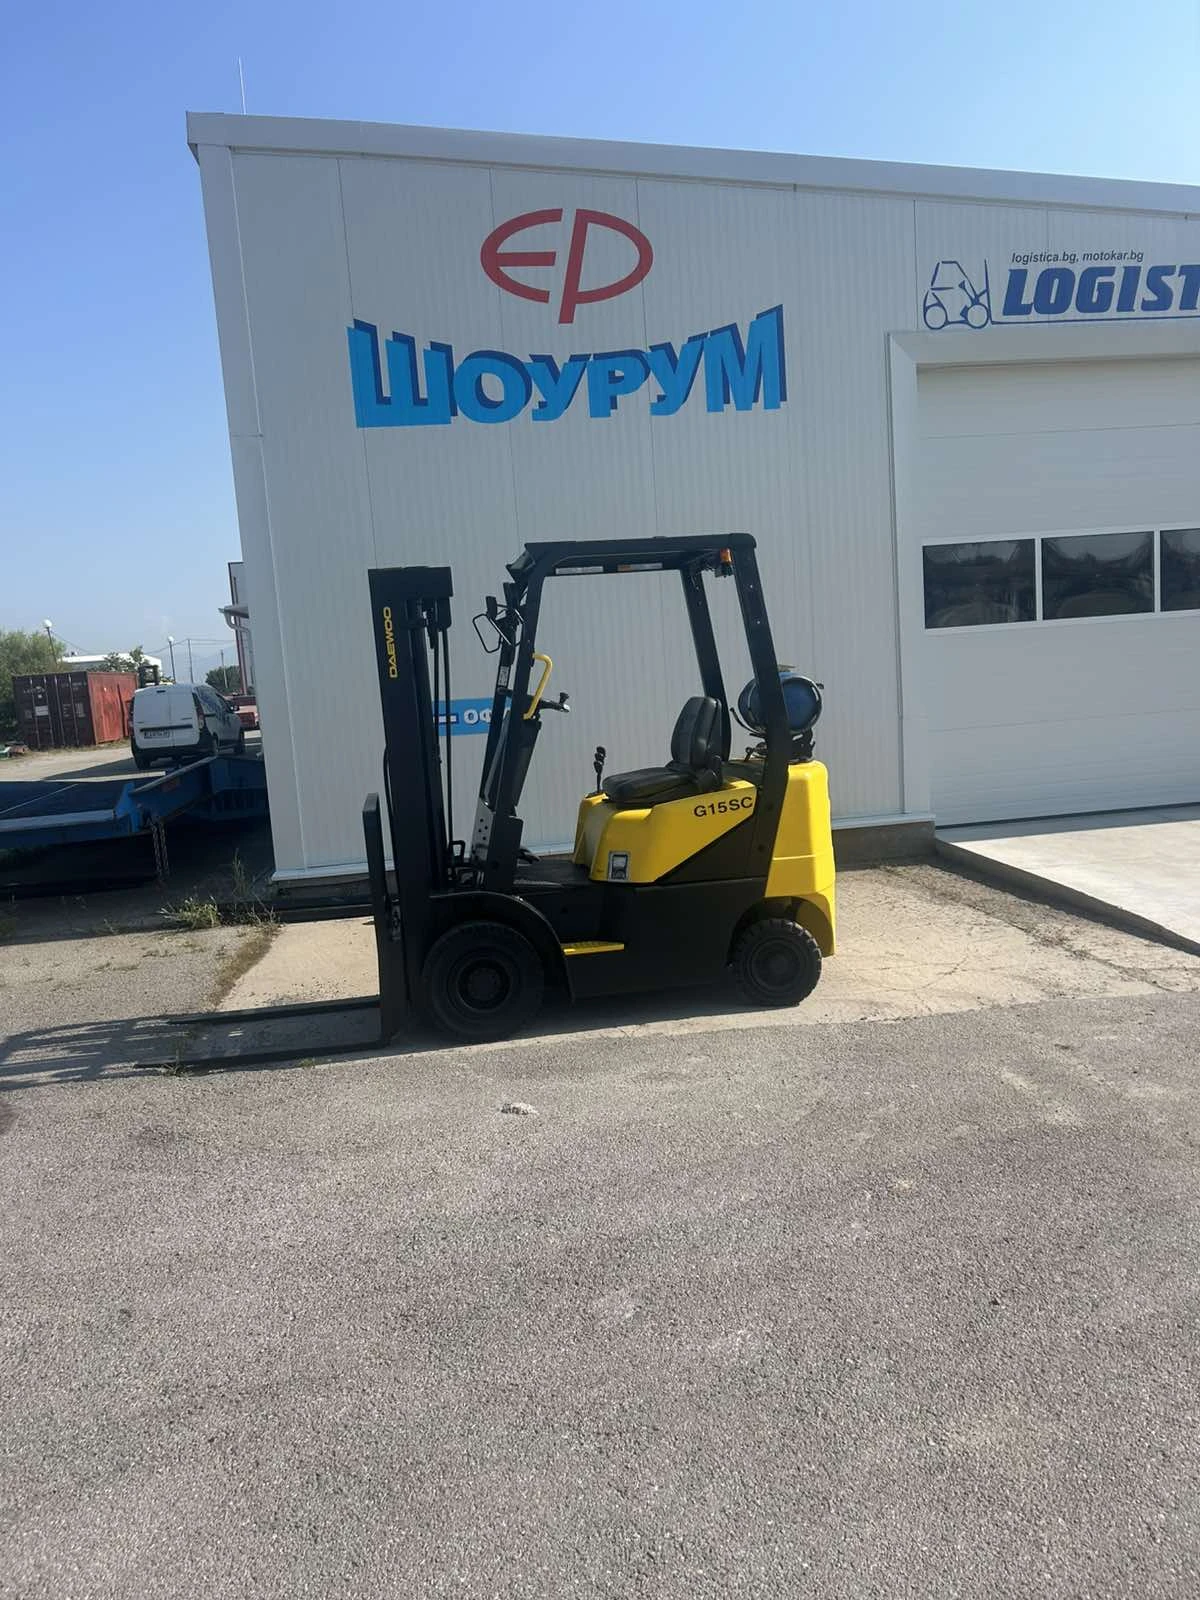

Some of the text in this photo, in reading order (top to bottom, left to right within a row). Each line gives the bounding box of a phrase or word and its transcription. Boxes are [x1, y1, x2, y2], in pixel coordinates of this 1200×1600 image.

[1011, 249, 1144, 265] logistica.bg, motokar.bg
[1002, 264, 1200, 316] LOGIST
[346, 304, 788, 429] ШОУРУМ
[383, 606, 398, 679] DAEWOO
[693, 796, 753, 818] G15SC
